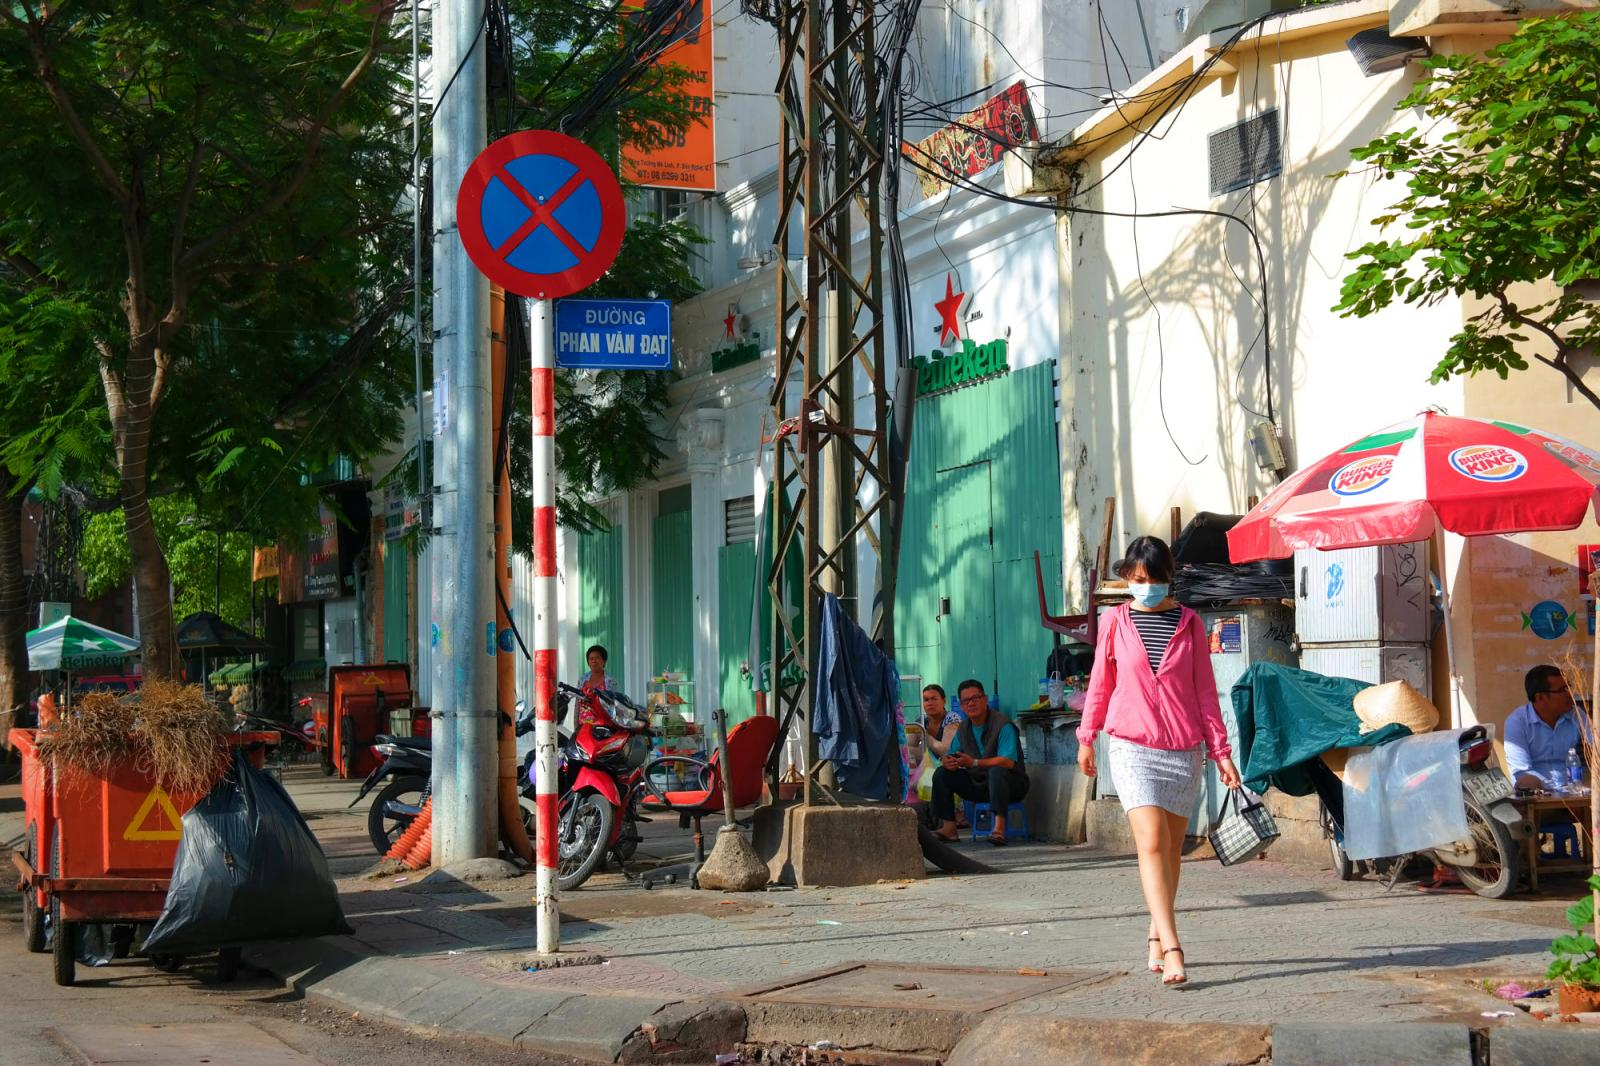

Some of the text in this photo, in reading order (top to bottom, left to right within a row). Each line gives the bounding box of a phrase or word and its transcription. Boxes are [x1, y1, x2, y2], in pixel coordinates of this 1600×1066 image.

[585, 306, 646, 325] ĐƯỜNG
[560, 330, 668, 357] PHAN VĂN ĐẠT
[1457, 448, 1508, 466] BURGER
[1465, 454, 1516, 475] KING
[1336, 468, 1393, 490] KING
[1340, 459, 1395, 480] BURGER
[63, 654, 131, 669] Heineken
